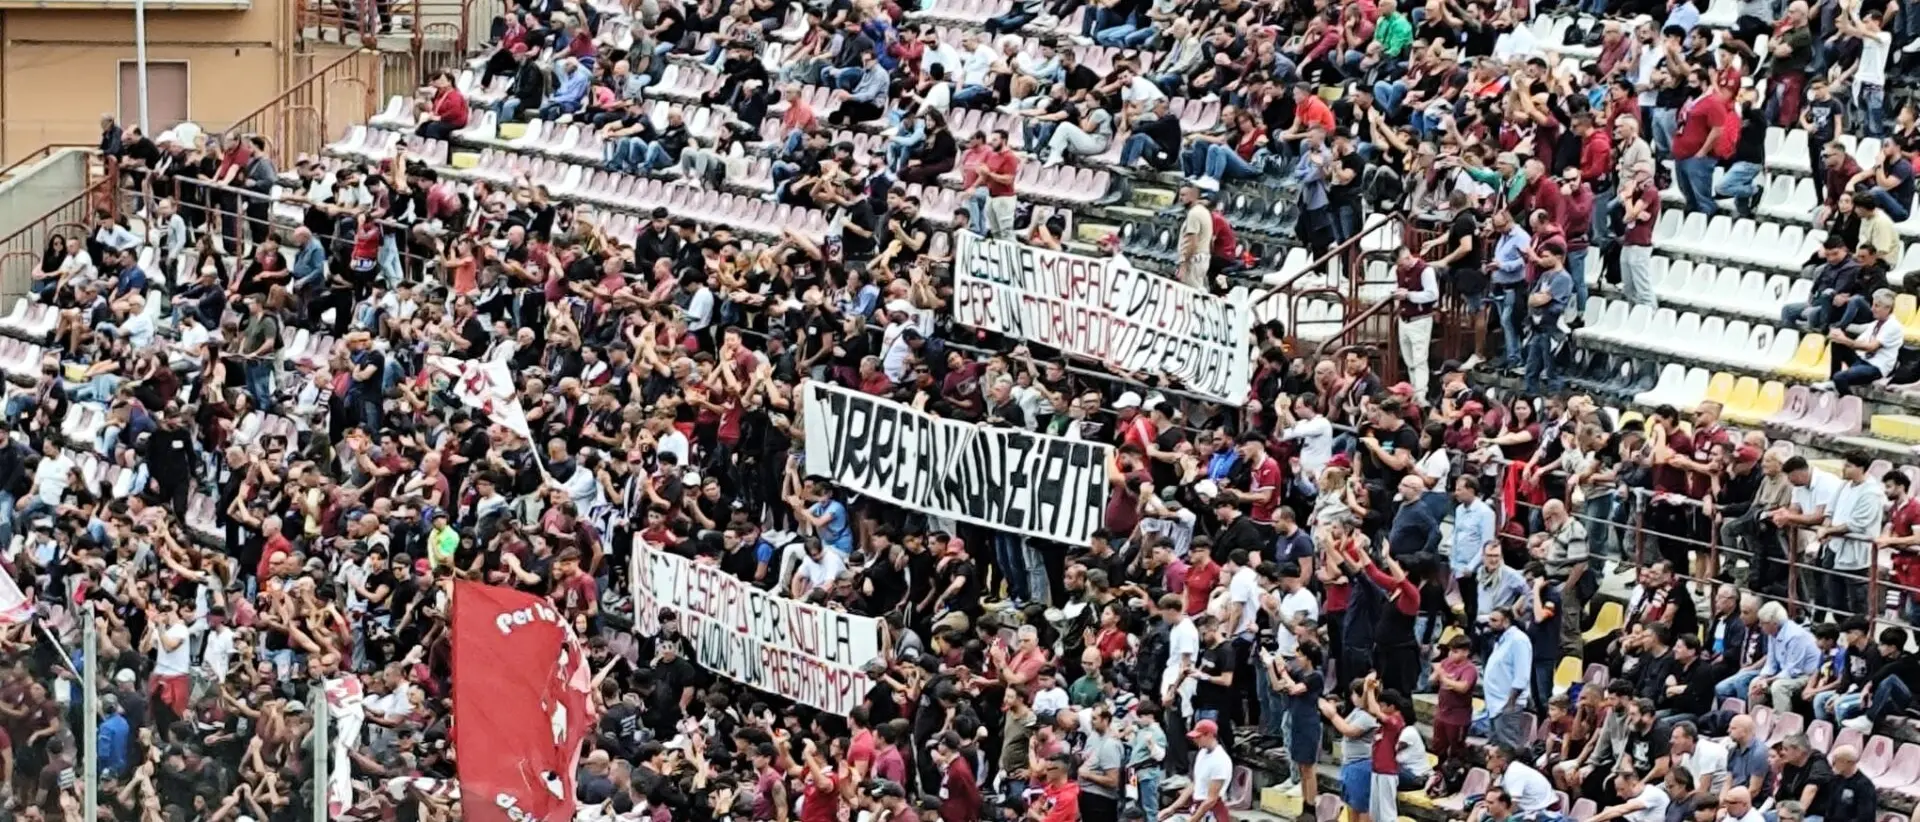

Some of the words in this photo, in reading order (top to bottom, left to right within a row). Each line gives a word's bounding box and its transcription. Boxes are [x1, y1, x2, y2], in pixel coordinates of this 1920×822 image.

[961, 235, 1036, 292] NESSUNA
[1040, 254, 1129, 312] MORALE
[1126, 272, 1160, 322] DA
[1158, 283, 1190, 335] CHI
[960, 279, 995, 326] PER
[998, 288, 1023, 336] UN
[1127, 327, 1234, 397] PERSONALE
[701, 619, 728, 671] NON
[741, 636, 761, 685] UN
[751, 591, 785, 643] PER
[824, 611, 852, 665] LA
